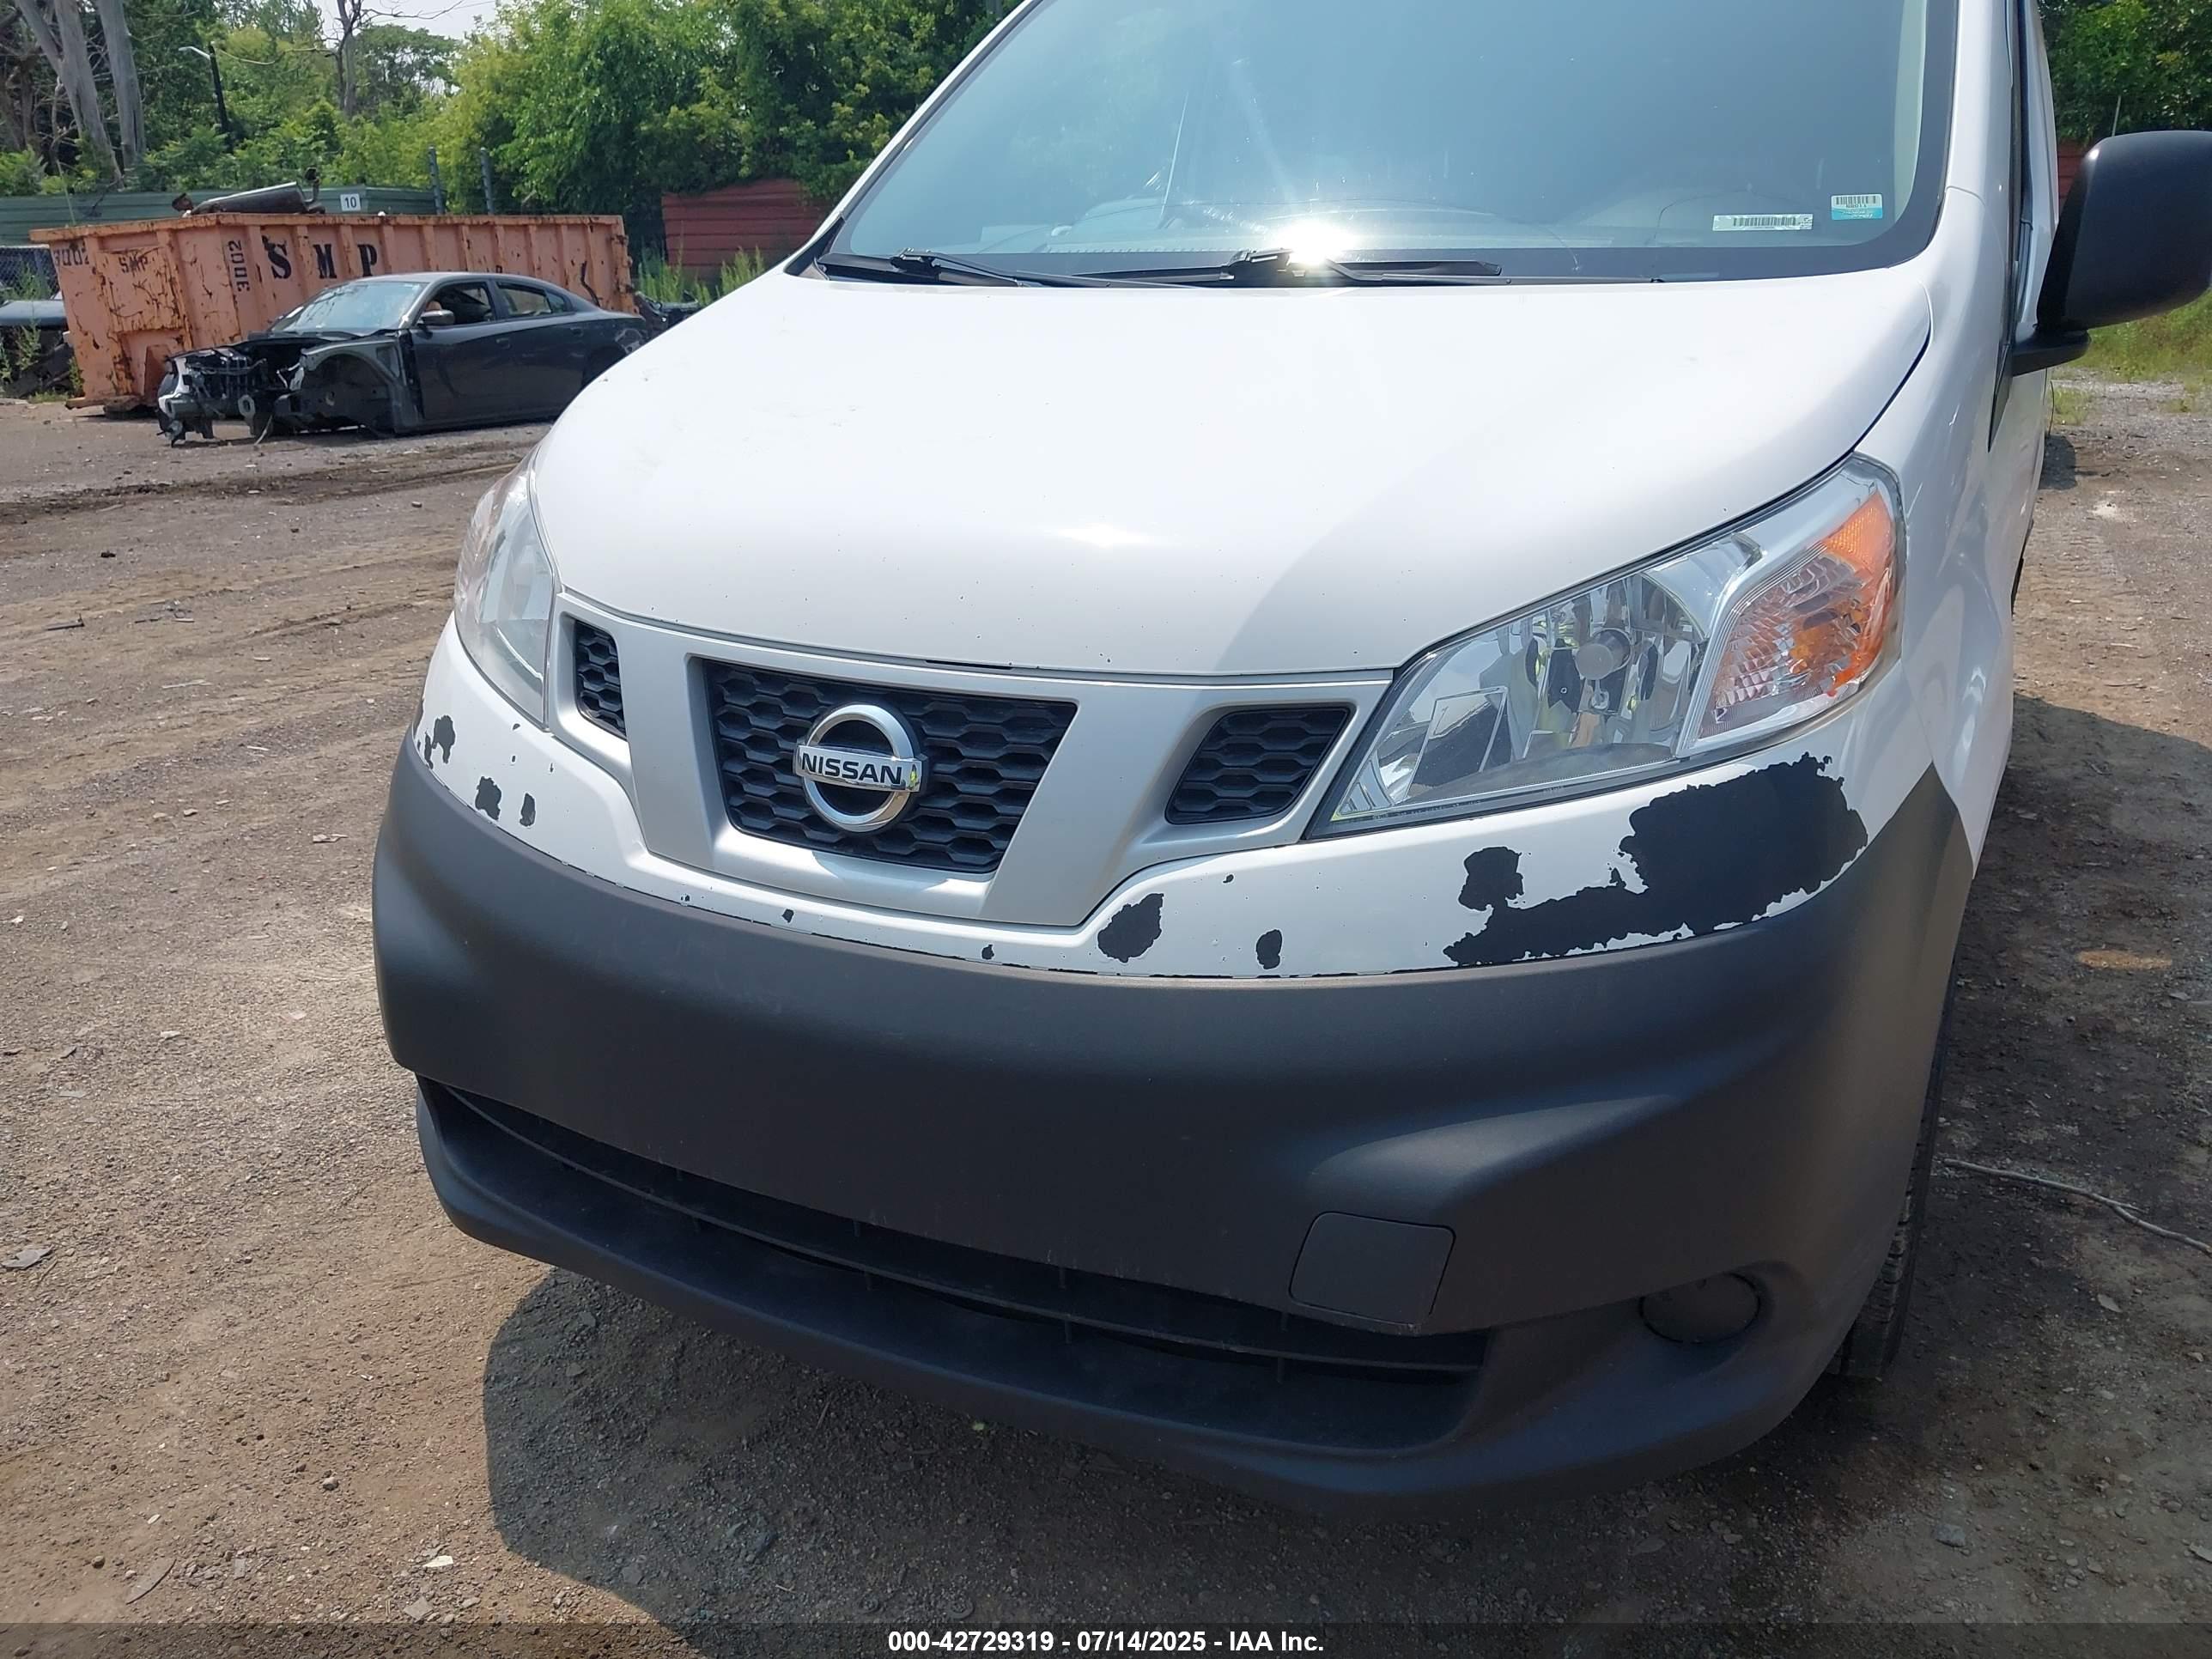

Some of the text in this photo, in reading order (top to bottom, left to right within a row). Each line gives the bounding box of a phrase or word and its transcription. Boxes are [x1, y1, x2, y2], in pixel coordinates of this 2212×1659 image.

[344, 197, 357, 209] 10
[228, 240, 250, 292] 3002
[801, 753, 902, 785] NISSAN
